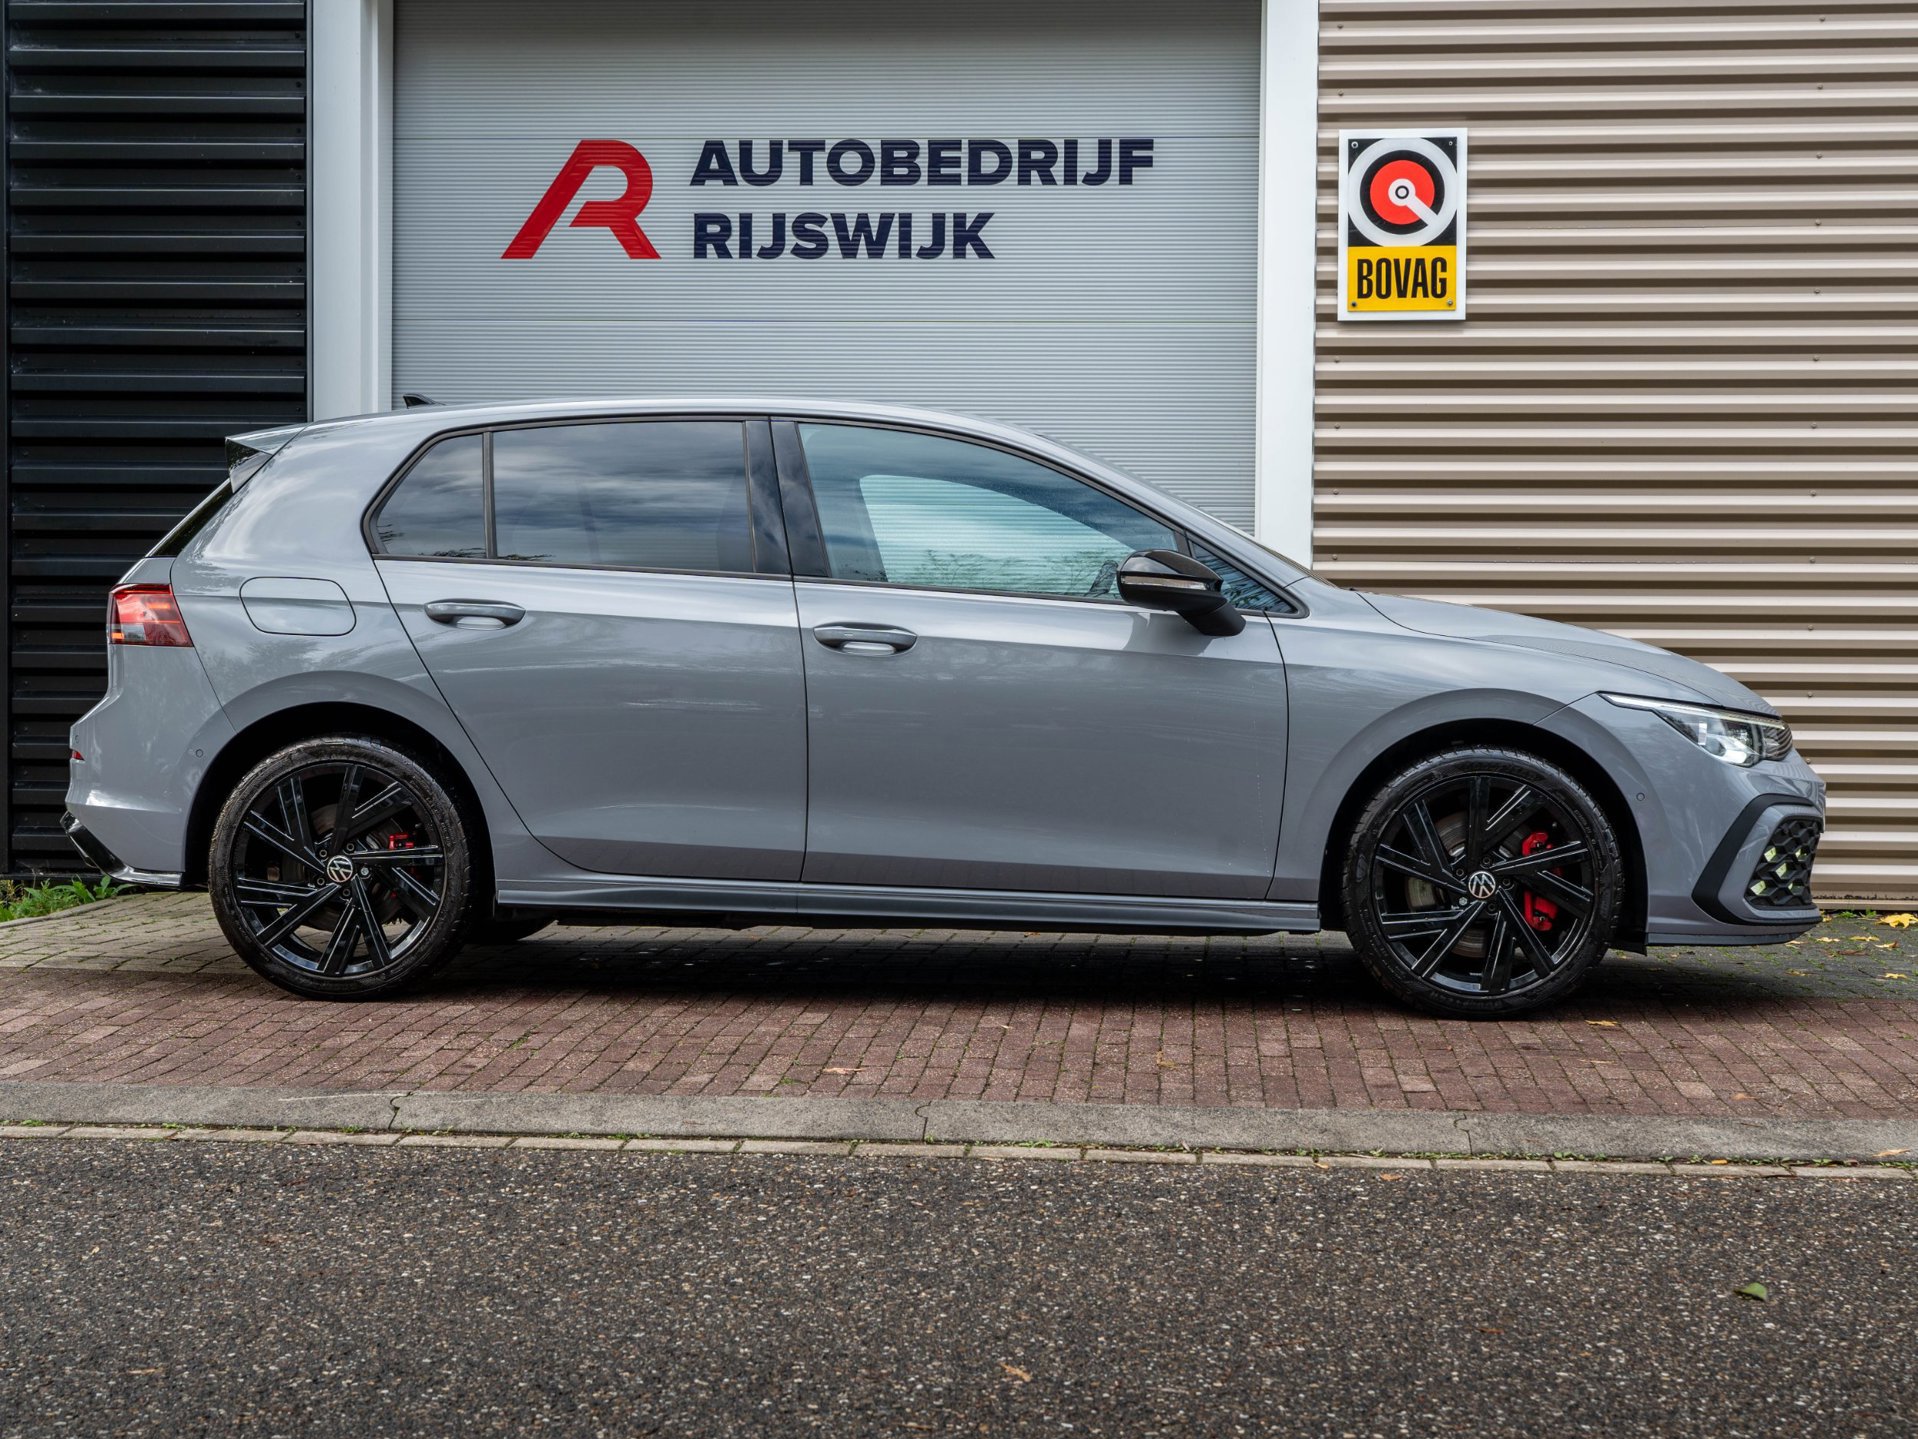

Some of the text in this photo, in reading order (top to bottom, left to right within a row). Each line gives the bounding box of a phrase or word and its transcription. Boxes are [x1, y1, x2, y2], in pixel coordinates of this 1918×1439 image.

[690, 138, 1155, 186] AUTOBEDRIJF
[693, 212, 995, 259] RIJSWIJK
[1357, 256, 1448, 299] BOVAG
